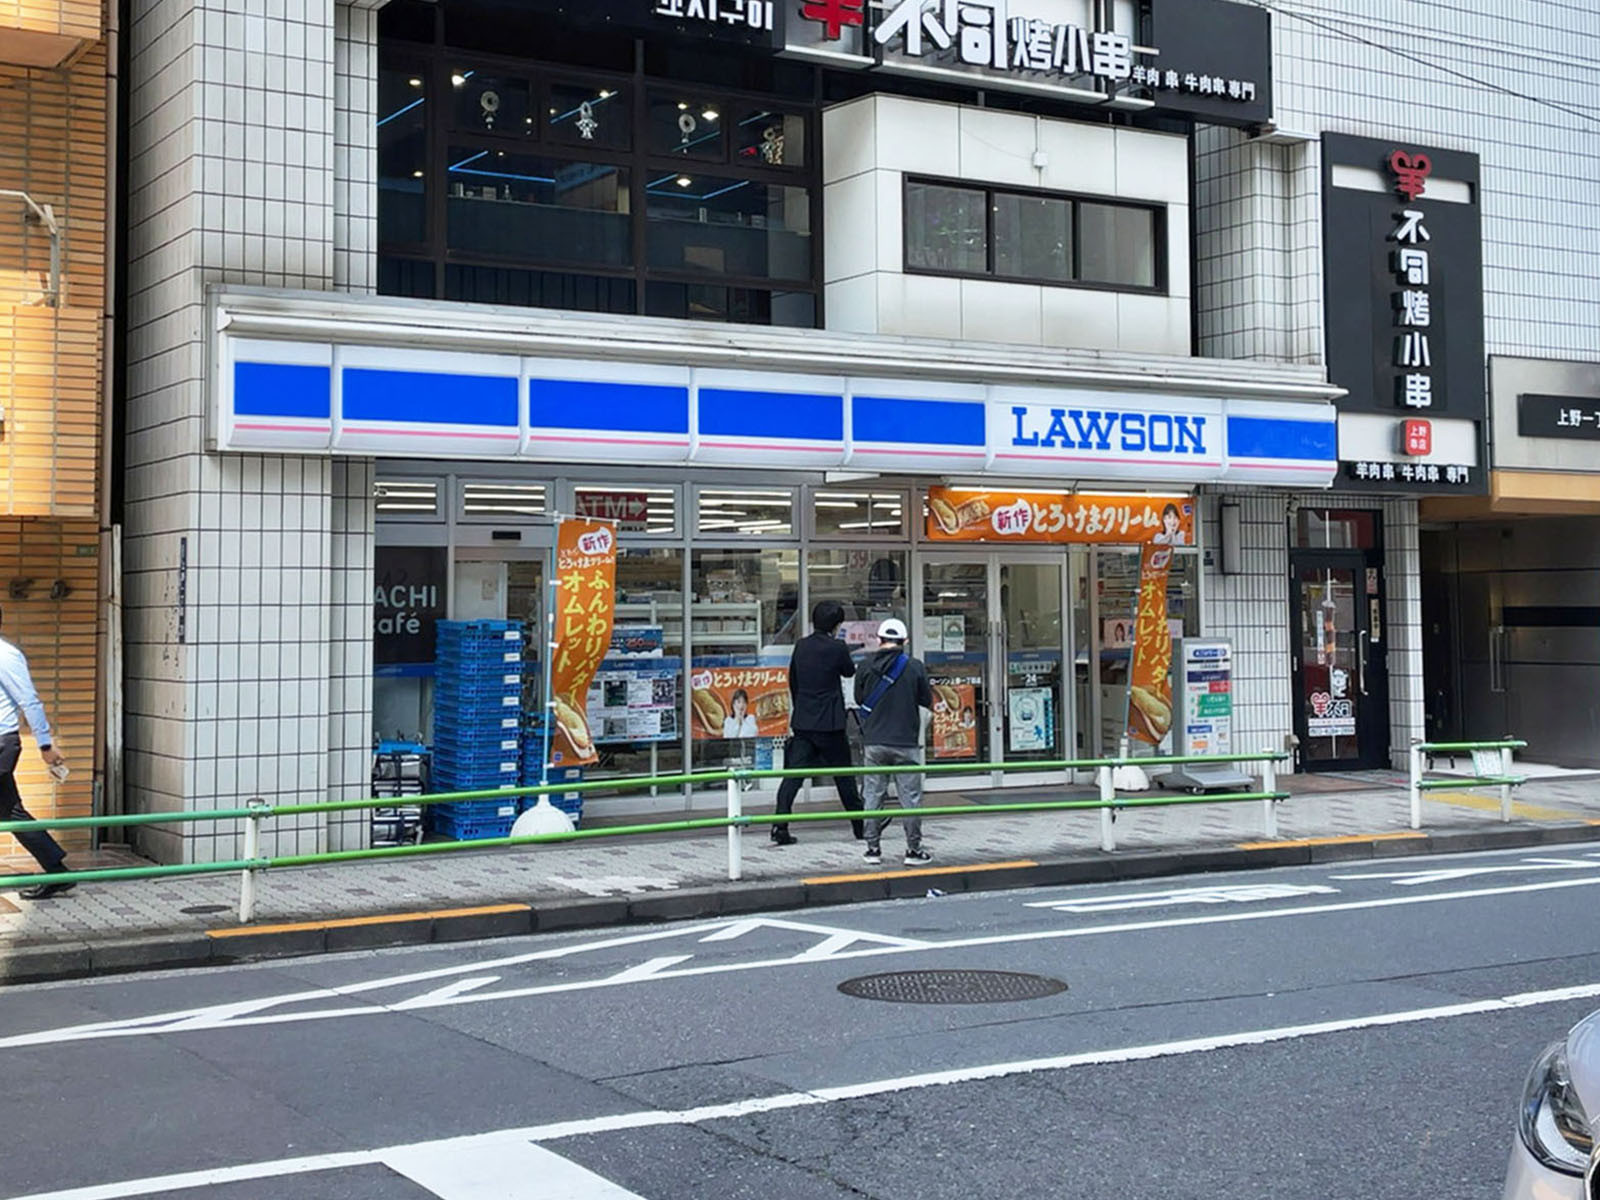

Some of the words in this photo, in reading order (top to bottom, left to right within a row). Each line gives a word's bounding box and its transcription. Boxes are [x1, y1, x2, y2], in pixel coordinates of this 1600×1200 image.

[1012, 406, 1206, 454] LAWSON
[997, 510, 1031, 530] 新作
[373, 611, 421, 635] afé
[557, 570, 586, 673] オムレット
